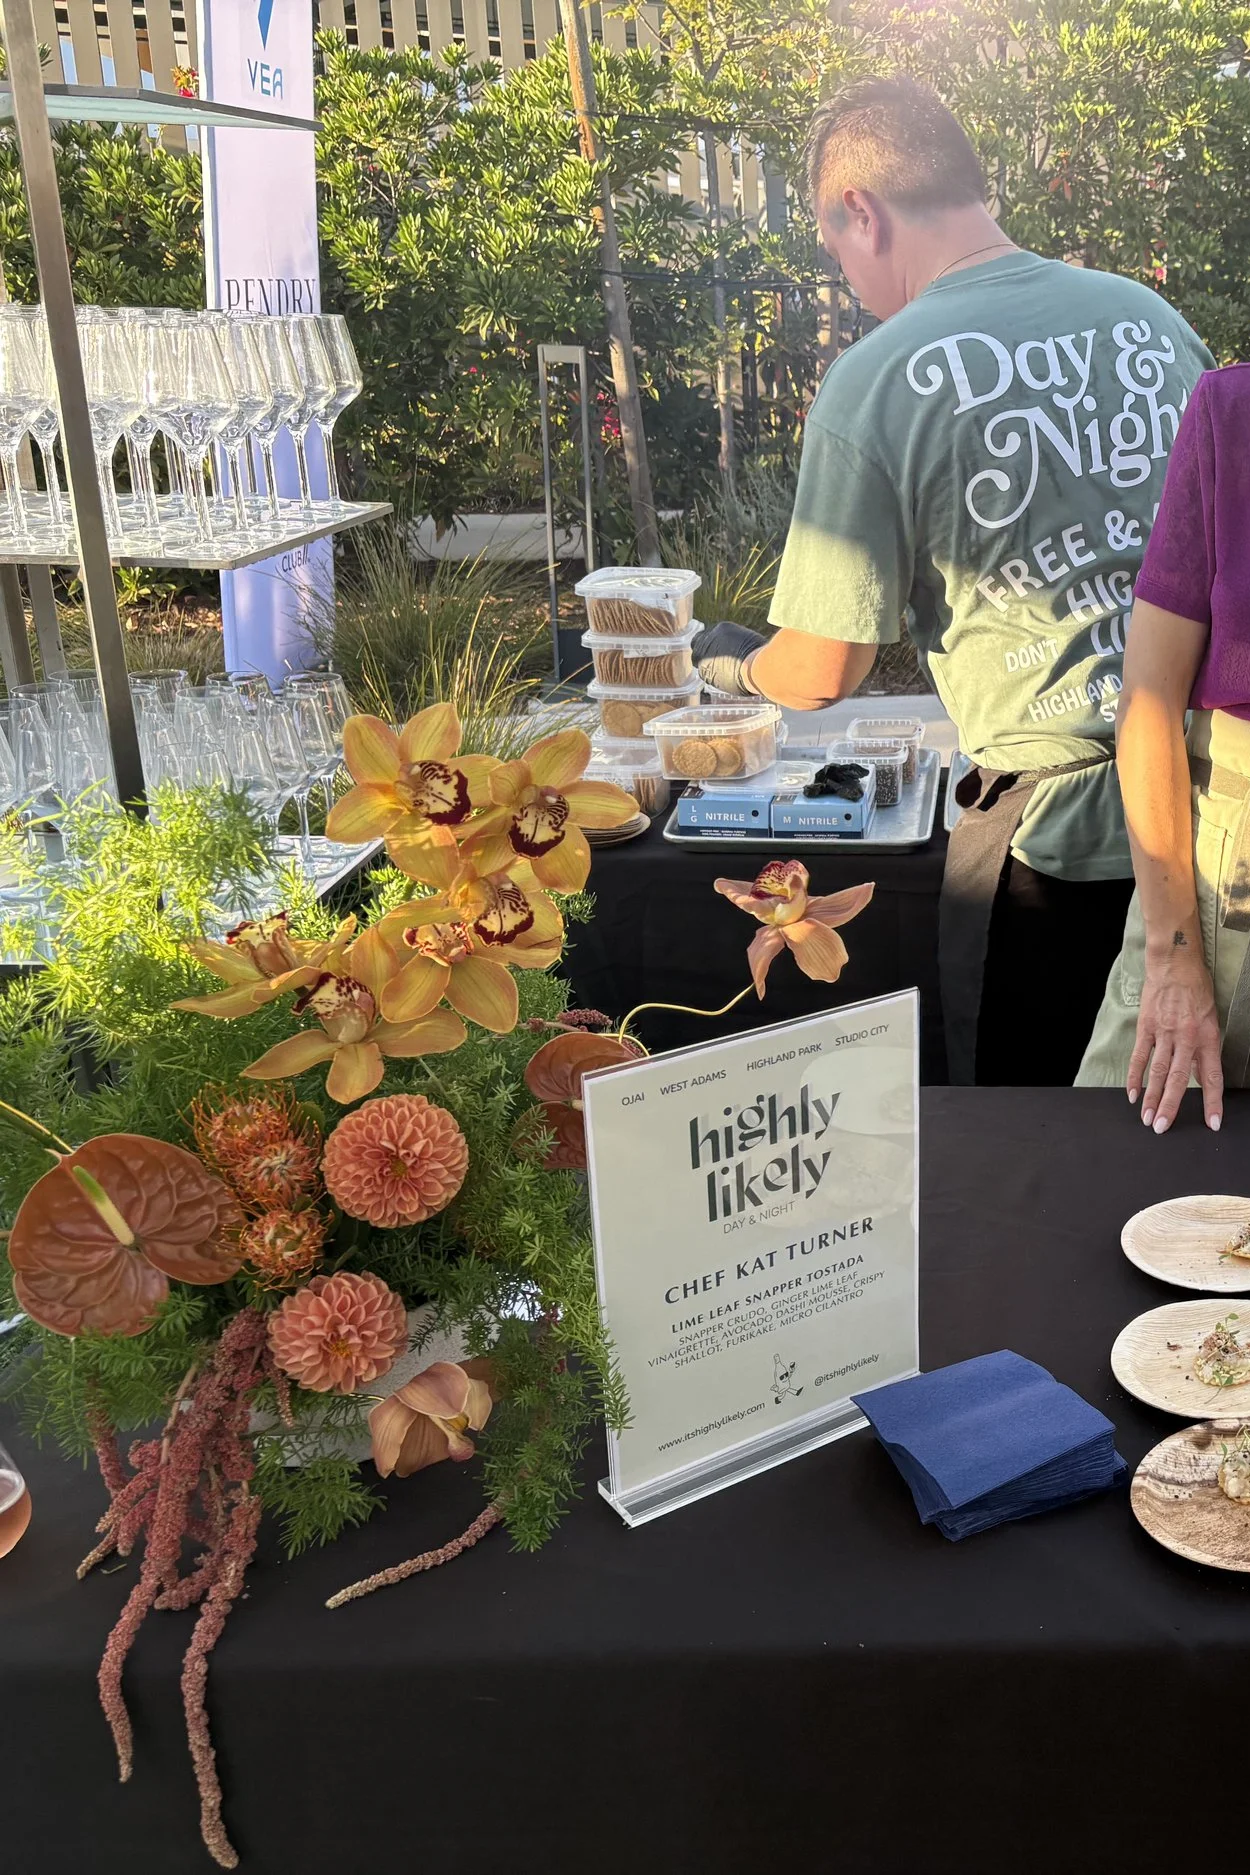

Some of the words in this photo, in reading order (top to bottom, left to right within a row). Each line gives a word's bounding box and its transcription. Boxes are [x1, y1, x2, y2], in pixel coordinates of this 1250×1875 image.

[247, 58, 284, 100] VEA
[224, 278, 317, 315] PENDRY
[906, 328, 1097, 416] Day
[1112, 319, 1176, 395] &
[965, 387, 1187, 530] Nigh
[976, 522, 1097, 614] FREE
[1104, 509, 1143, 551] &
[1005, 639, 1060, 673] DON'T
[1027, 673, 1123, 723] HIGHLAND
[705, 812, 745, 822] NITRILE
[783, 816, 792, 824] M
[798, 817, 839, 826] NITRILE
[746, 1050, 796, 1072] HIGHLAND
[798, 1043, 823, 1057] PARK
[835, 1030, 868, 1047] STUDIO
[870, 1024, 890, 1038] CITY
[621, 1092, 645, 1106] OJAI
[660, 1080, 687, 1096] WEST
[691, 1070, 727, 1089] ADAMS
[689, 1083, 841, 1170] highly
[706, 1144, 832, 1222] likely
[723, 1219, 746, 1234] DAY
[749, 1215, 757, 1226] &
[759, 1200, 796, 1223] NIGHT
[664, 1270, 726, 1304] CHEF
[736, 1250, 778, 1280] KAT
[785, 1216, 874, 1261] TURNER
[648, 1336, 719, 1368] VINAIGRETTE,
[721, 1312, 773, 1340] AVOCADO
[776, 1301, 807, 1319] DASHI
[808, 1285, 852, 1309] MOUSSE,
[854, 1270, 885, 1290] CRISPY
[672, 1313, 704, 1334] LIME
[710, 1300, 741, 1322] LEAF
[745, 1277, 803, 1306] SNAPPER
[806, 1254, 864, 1283] TOSTADA
[679, 1324, 724, 1346] SNAPPER
[727, 1308, 768, 1332] CRUDO,
[771, 1290, 809, 1312] GINGER
[811, 1281, 834, 1298] LIME
[836, 1271, 859, 1288] LEAF
[674, 1343, 723, 1369] SHALLOT,
[726, 1324, 777, 1349] FURIKAKE,
[779, 1309, 813, 1328] MICRO
[815, 1289, 864, 1314] CILANTRO
[814, 1352, 880, 1387] @itshighlylikely
[658, 1401, 766, 1452] www.itshighlylikely.com
